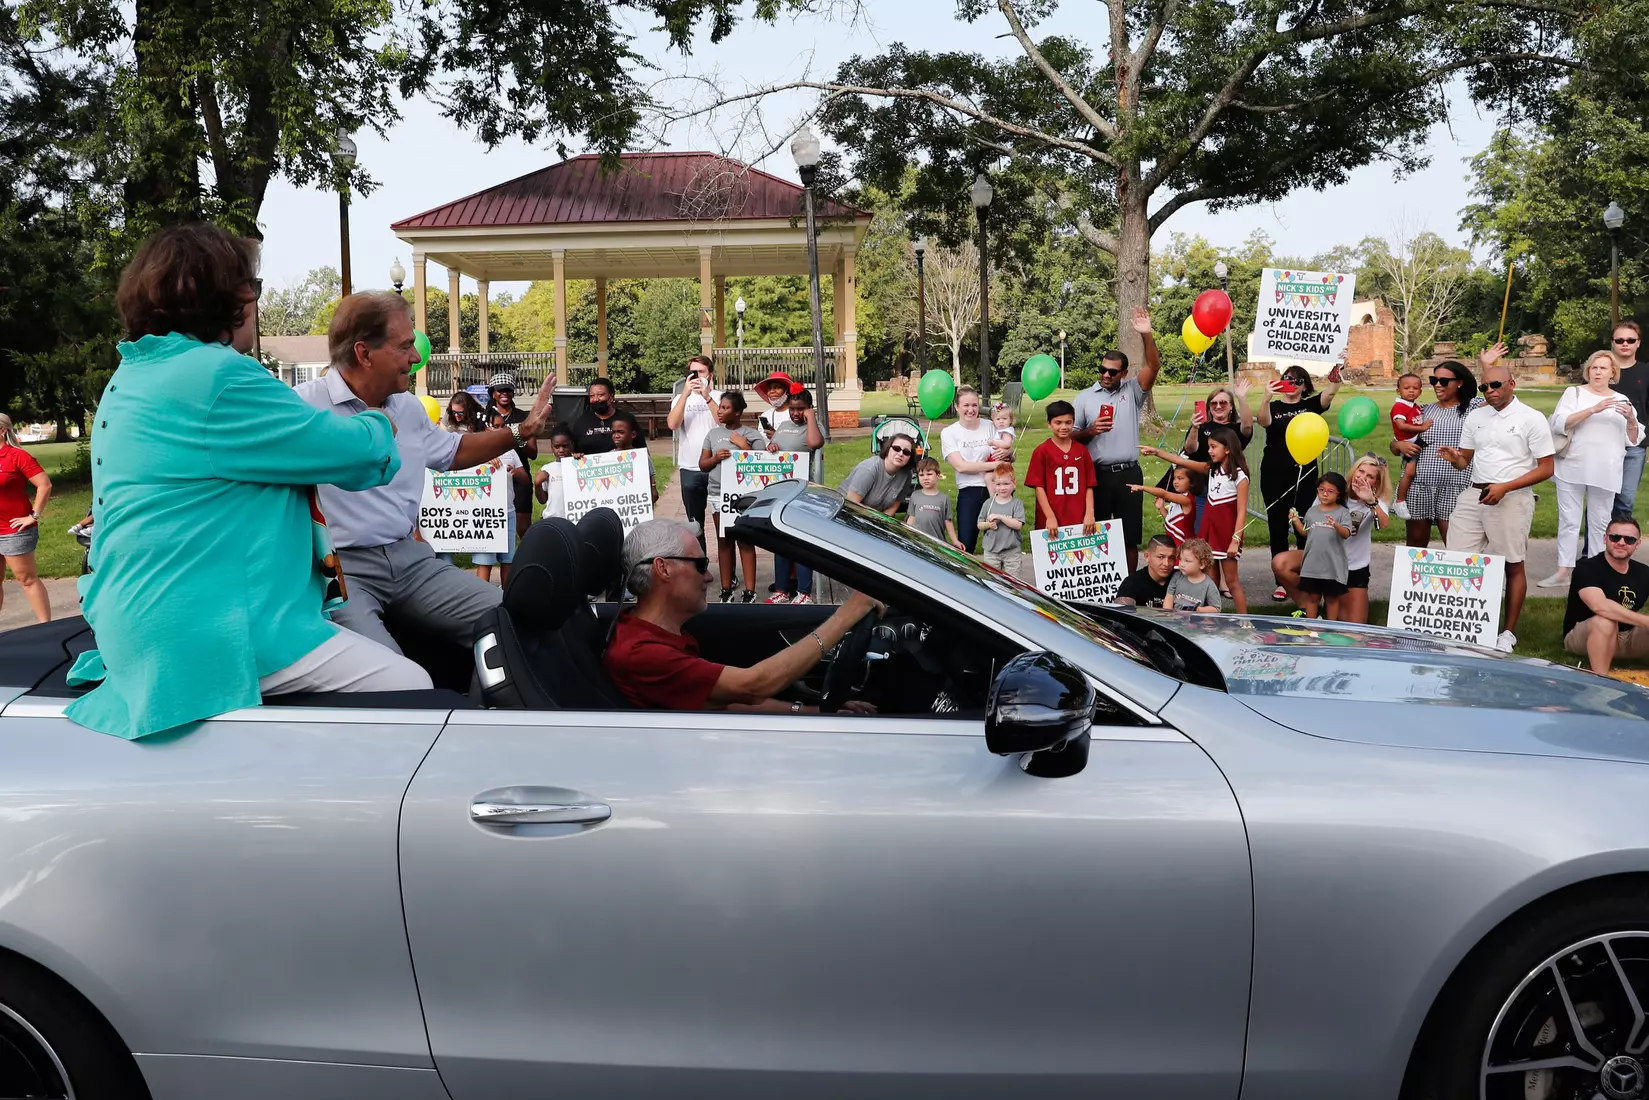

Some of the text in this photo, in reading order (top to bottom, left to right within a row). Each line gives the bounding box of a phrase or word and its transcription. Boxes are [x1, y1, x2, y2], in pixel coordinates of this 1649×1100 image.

[1278, 284, 1304, 292] NICK'S
[1268, 308, 1339, 322] UNIVERSITY
[1262, 318, 1341, 333] of ALABAMA
[1267, 329, 1335, 344] CHILDREN'S
[1268, 340, 1330, 355] PROGRAM
[578, 468, 603, 478] NICK'S
[604, 465, 622, 474] KIDS
[435, 478, 460, 486] NICK'S
[462, 478, 480, 486] KIDS
[1055, 466, 1079, 495] 13
[567, 498, 597, 511] BOYS
[617, 492, 649, 505] GIRLS
[421, 507, 452, 517] BOYS
[472, 508, 505, 518] GIRLS
[618, 503, 651, 516] WEST
[420, 519, 507, 529] CLUB OF WEST
[433, 530, 494, 539] ALABAMA
[1049, 540, 1076, 551] NICK'S
[1077, 537, 1096, 547] KIDS
[1050, 543, 1108, 560] JUBILEE
[1046, 561, 1116, 579] UNIVERSITY
[1413, 564, 1444, 573] NICK'S
[1446, 566, 1469, 576] KIDS
[1044, 572, 1122, 591] of ALABAMA
[1412, 573, 1481, 587] JUBILEE
[1404, 590, 1487, 609] UNIVERSITY
[1397, 602, 1490, 622] of ALABAMA
[1403, 615, 1482, 634] CHILDREN'S
